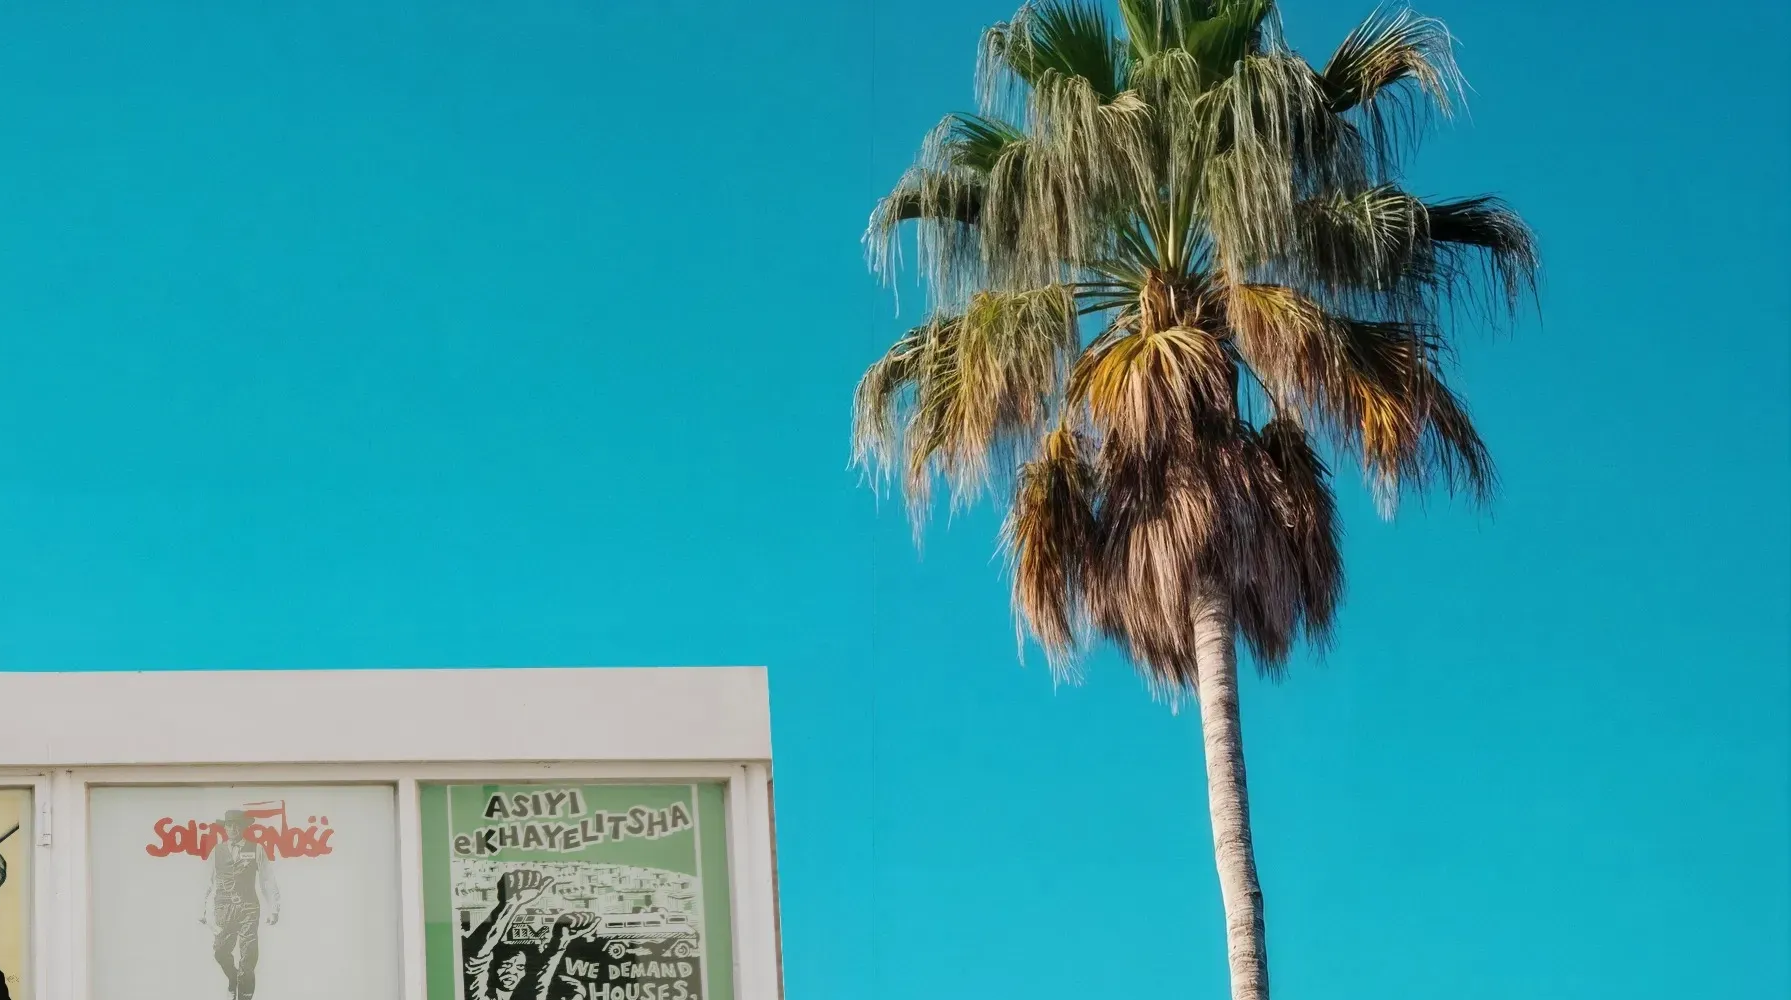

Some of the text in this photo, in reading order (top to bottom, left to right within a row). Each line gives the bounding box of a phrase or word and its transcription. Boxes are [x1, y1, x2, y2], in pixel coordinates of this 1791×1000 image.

[484, 790, 582, 819] ASIYI
[565, 957, 693, 980] WE DEMAND
